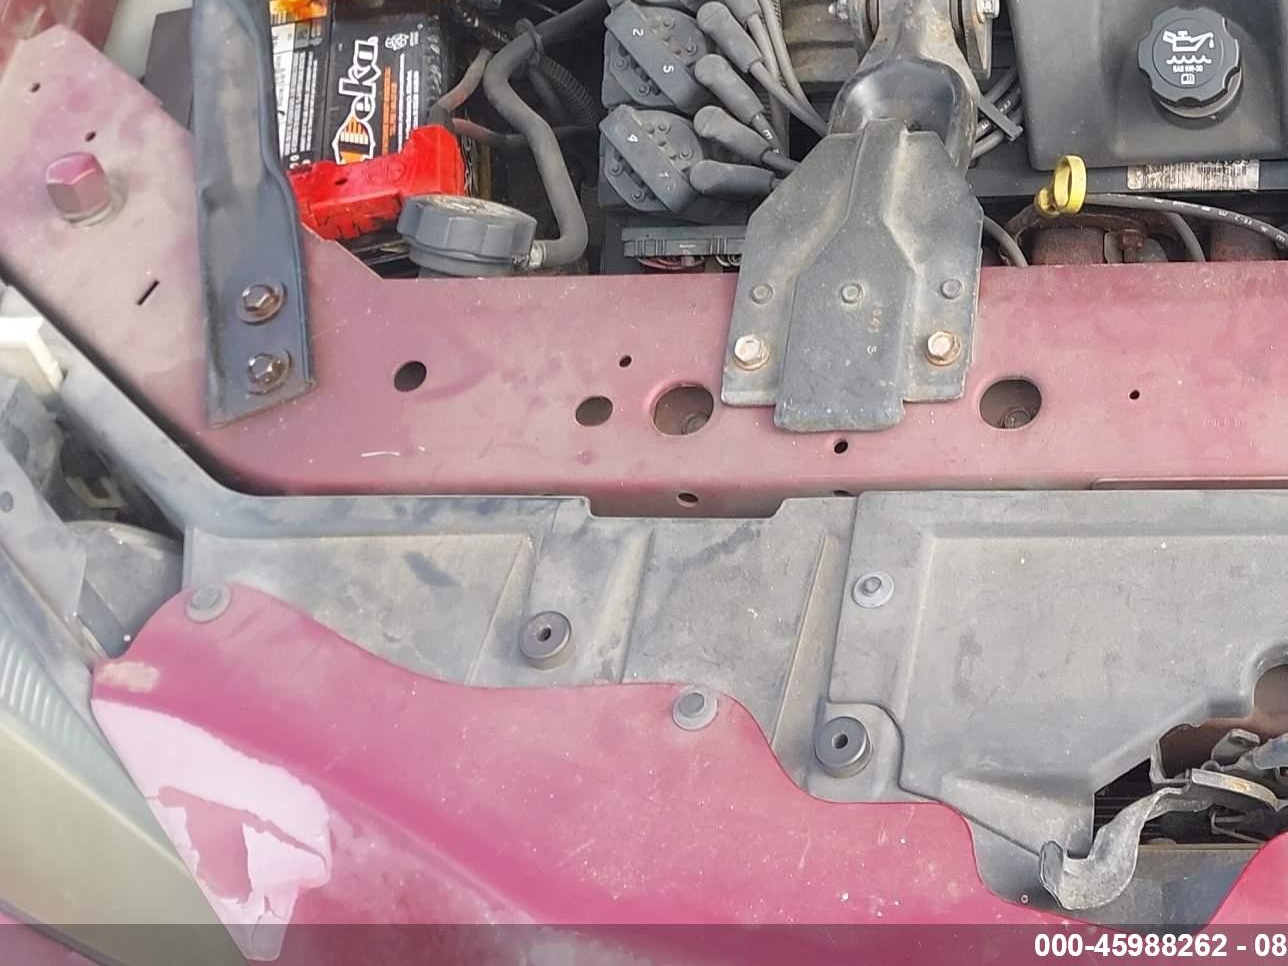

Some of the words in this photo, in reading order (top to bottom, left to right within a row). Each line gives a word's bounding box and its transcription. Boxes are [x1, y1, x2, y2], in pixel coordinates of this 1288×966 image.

[632, 28, 644, 37] 2
[663, 64, 675, 73] 5
[627, 134, 640, 143] 4
